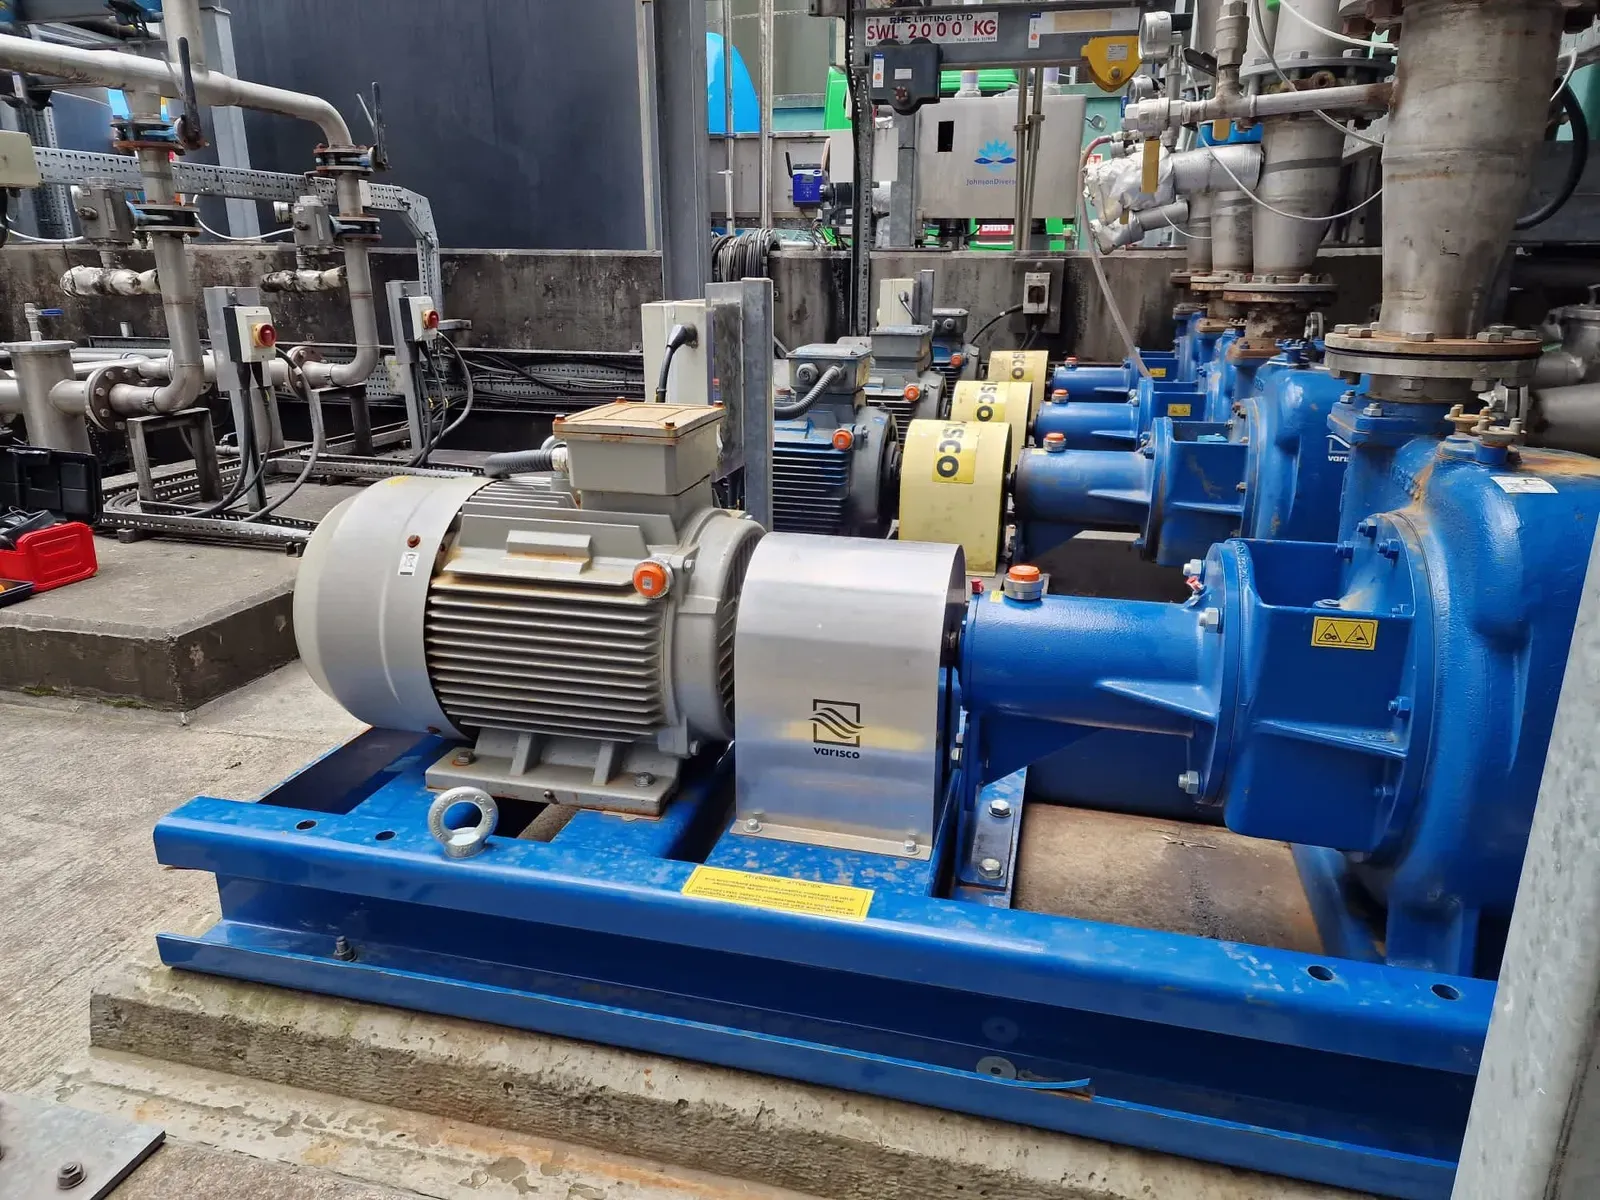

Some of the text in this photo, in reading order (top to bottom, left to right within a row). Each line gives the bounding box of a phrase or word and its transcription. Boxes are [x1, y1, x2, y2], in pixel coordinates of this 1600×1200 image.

[914, 15, 953, 23] LIFTING
[867, 19, 997, 40] SWL 2000 KG
[976, 380, 998, 422] ISCO
[813, 747, 860, 759] varisco
